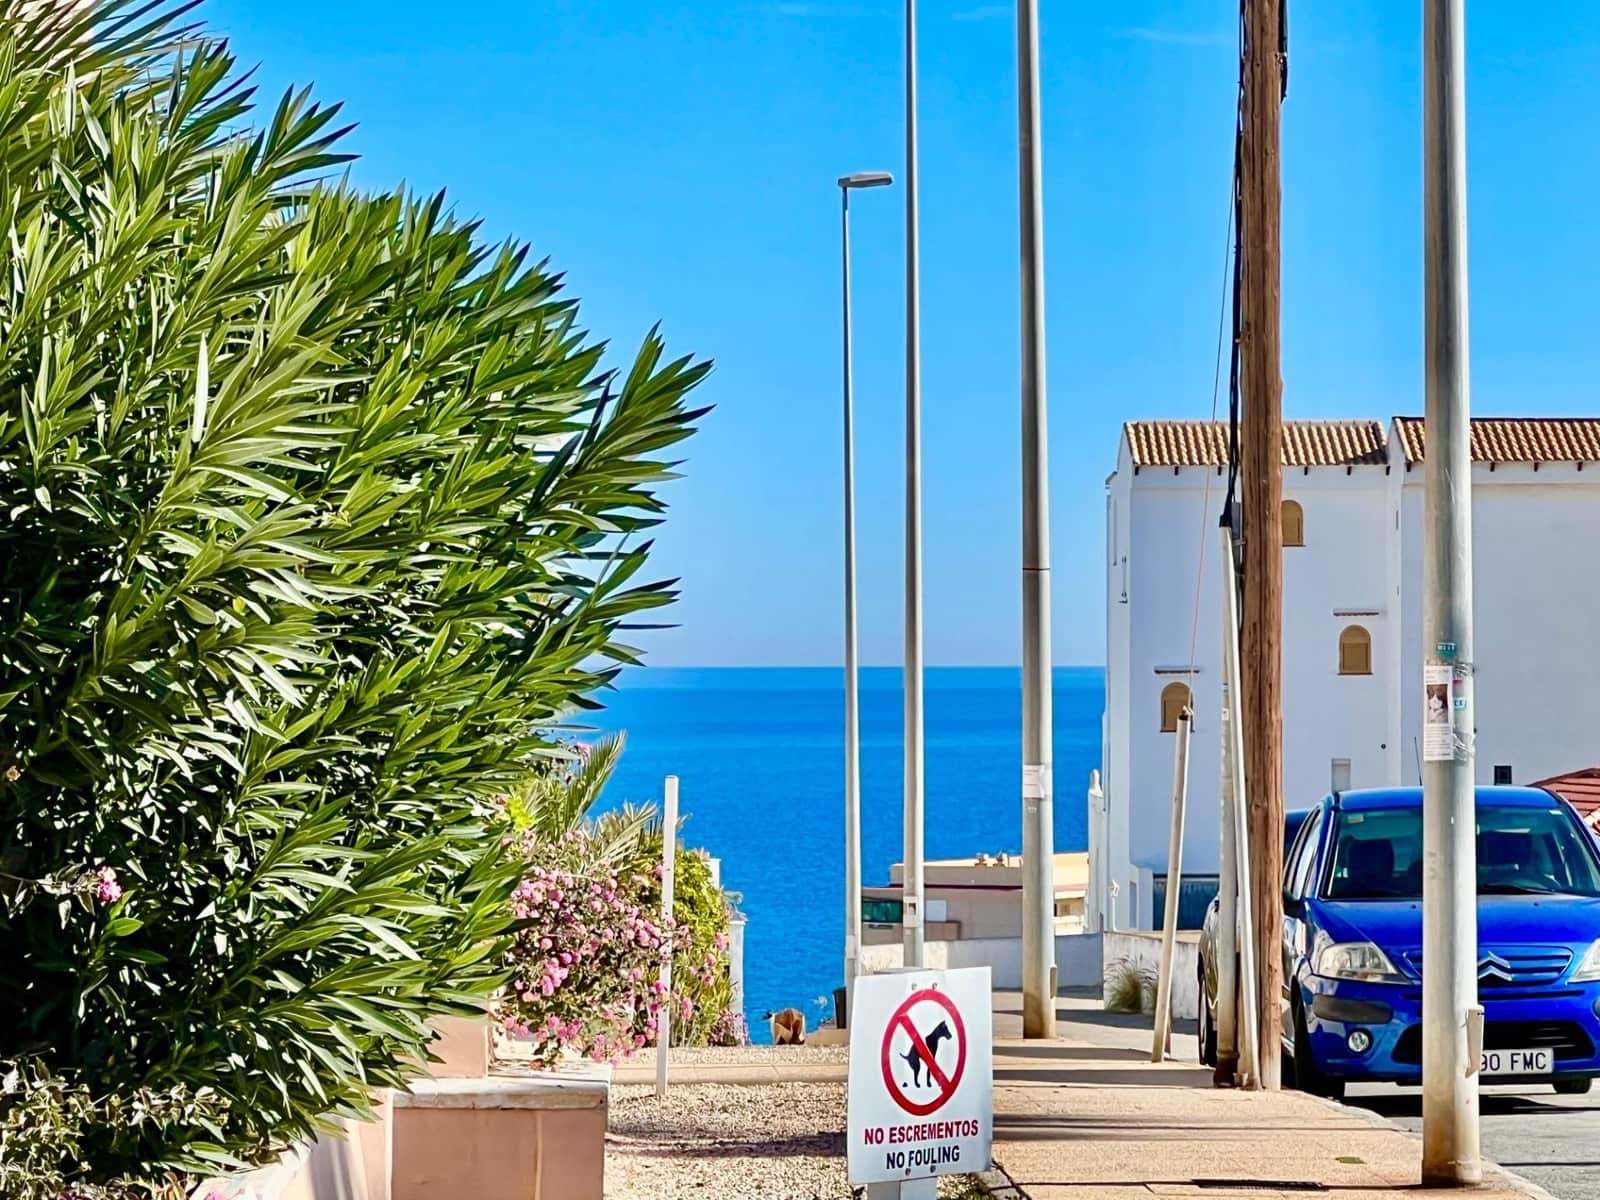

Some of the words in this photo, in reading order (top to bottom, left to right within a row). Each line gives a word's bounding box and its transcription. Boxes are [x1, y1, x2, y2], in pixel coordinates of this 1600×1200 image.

[1510, 1052, 1547, 1071] FMC
[864, 1127, 884, 1145] NO
[889, 1119, 979, 1144] ESCREMENTOS
[886, 1149, 905, 1170] NO
[908, 1145, 960, 1169] FOULING
